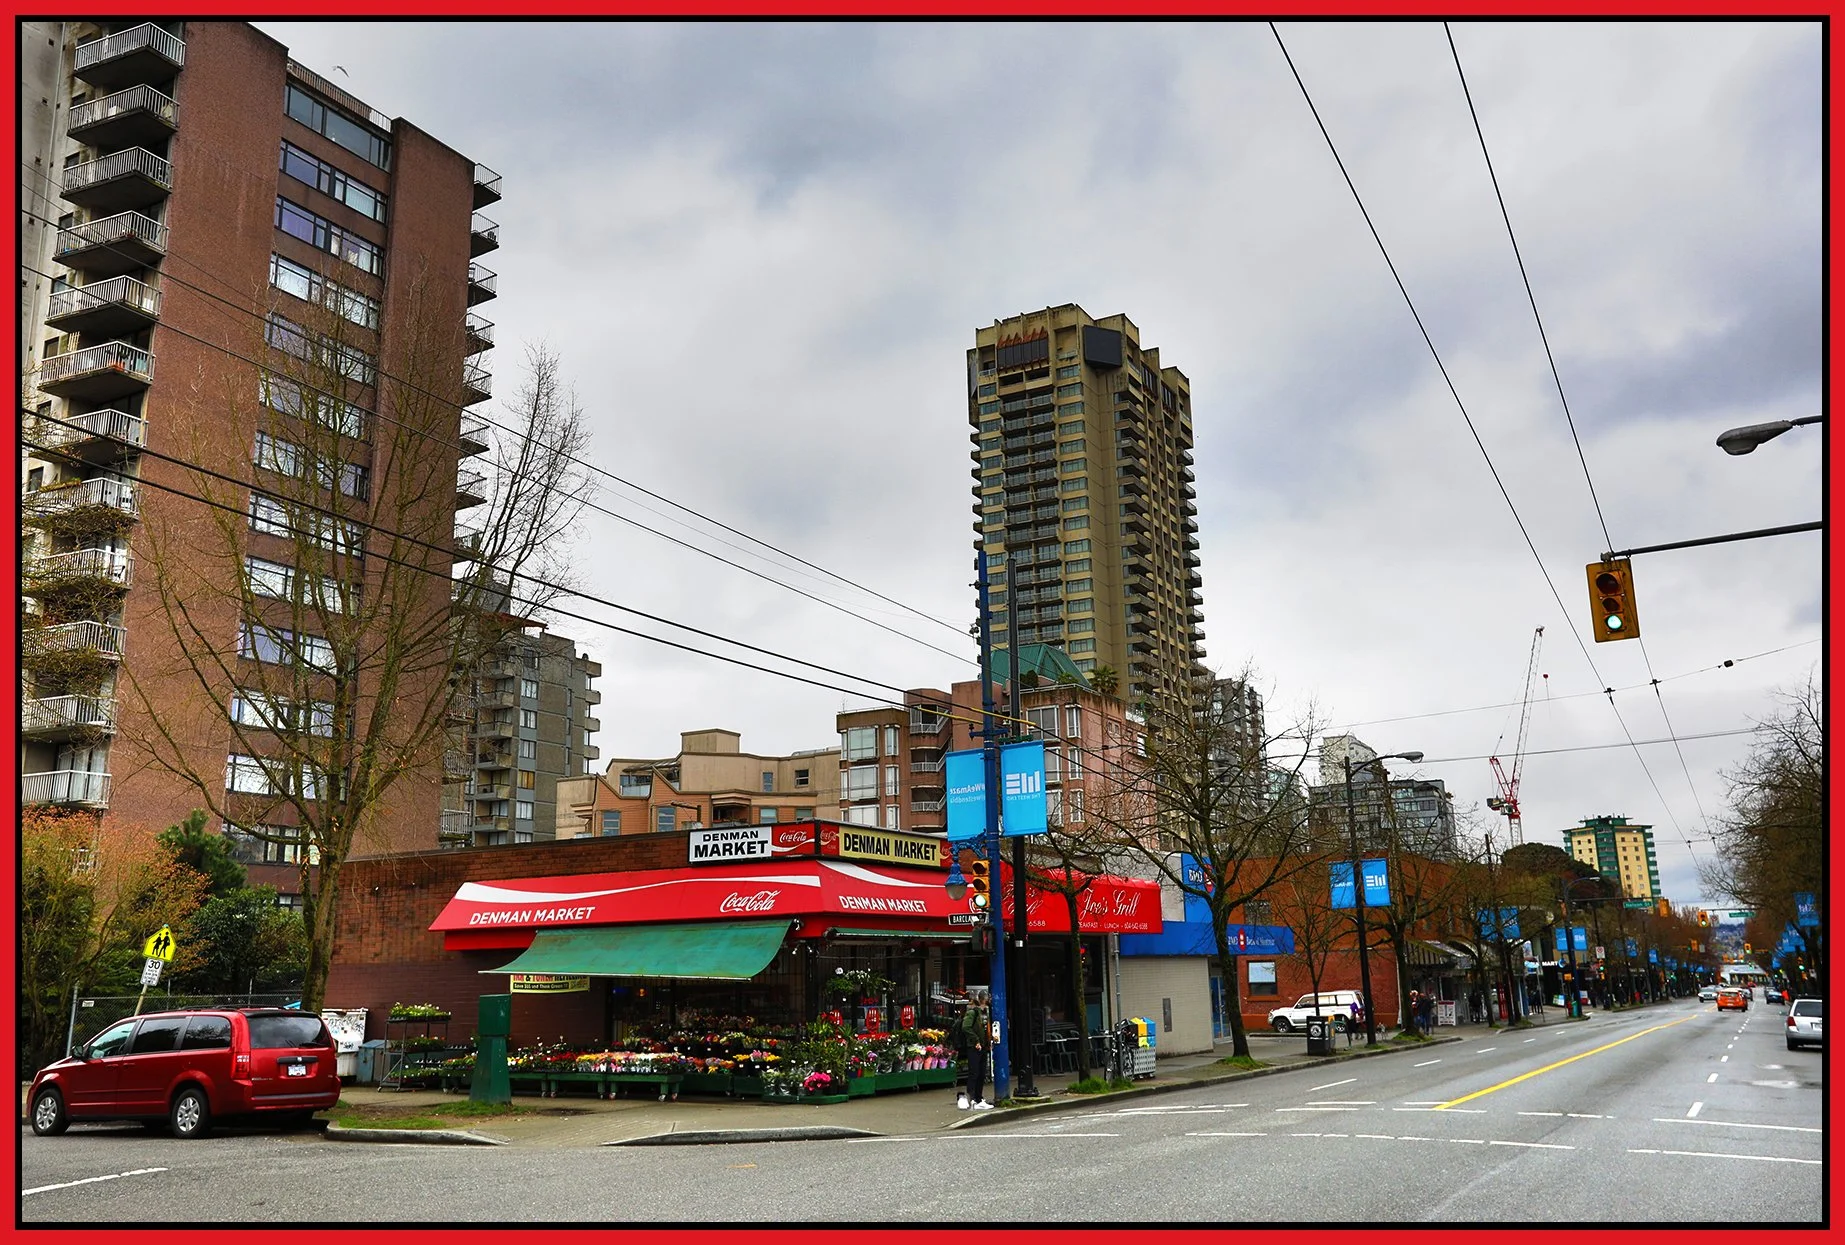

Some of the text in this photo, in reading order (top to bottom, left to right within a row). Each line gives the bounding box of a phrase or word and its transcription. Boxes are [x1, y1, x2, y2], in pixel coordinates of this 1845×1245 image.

[703, 829, 759, 842] DENMAN
[694, 840, 768, 858] MARKET
[843, 832, 890, 856] DENMAN
[894, 839, 937, 861] MARKET
[839, 895, 928, 913] DENMAN MARKET
[1079, 887, 1141, 921] Joe's Grill
[469, 906, 595, 925] DENMAN MARKET
[952, 915, 974, 924] BARCLA
[148, 960, 161, 970] 30
